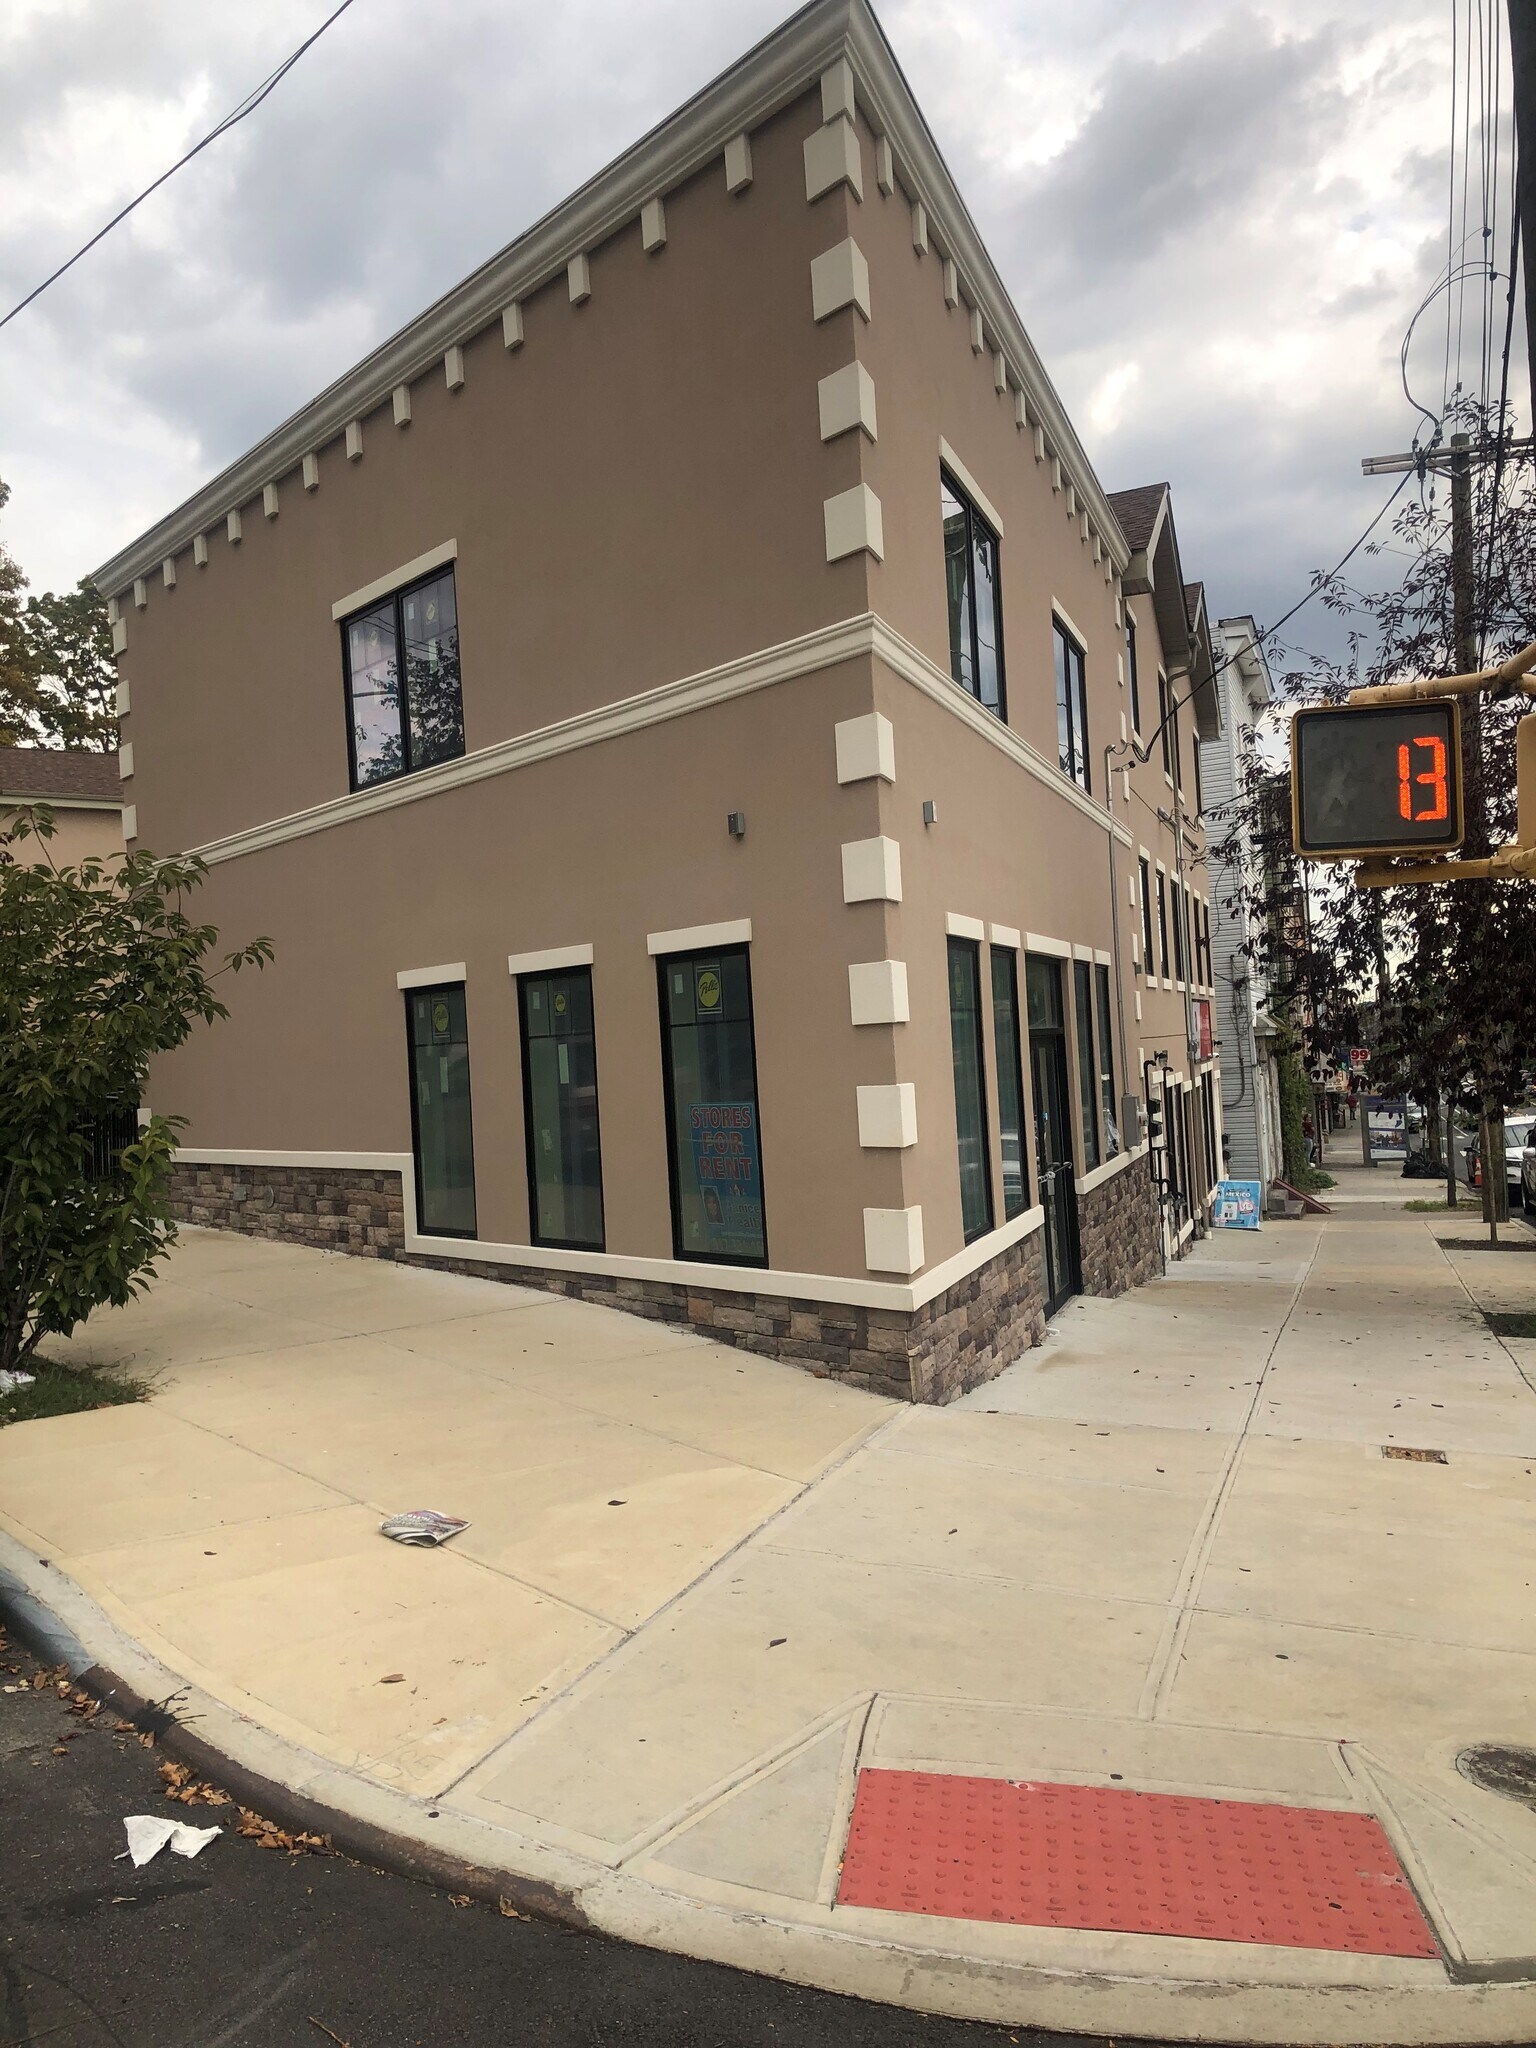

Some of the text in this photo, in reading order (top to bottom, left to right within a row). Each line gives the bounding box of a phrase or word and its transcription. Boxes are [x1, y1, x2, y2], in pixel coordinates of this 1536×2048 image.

[1398, 736, 1448, 821] 13
[691, 1106, 752, 1129] STORES
[701, 1131, 745, 1155] FOR
[699, 1156, 752, 1180] RENT
